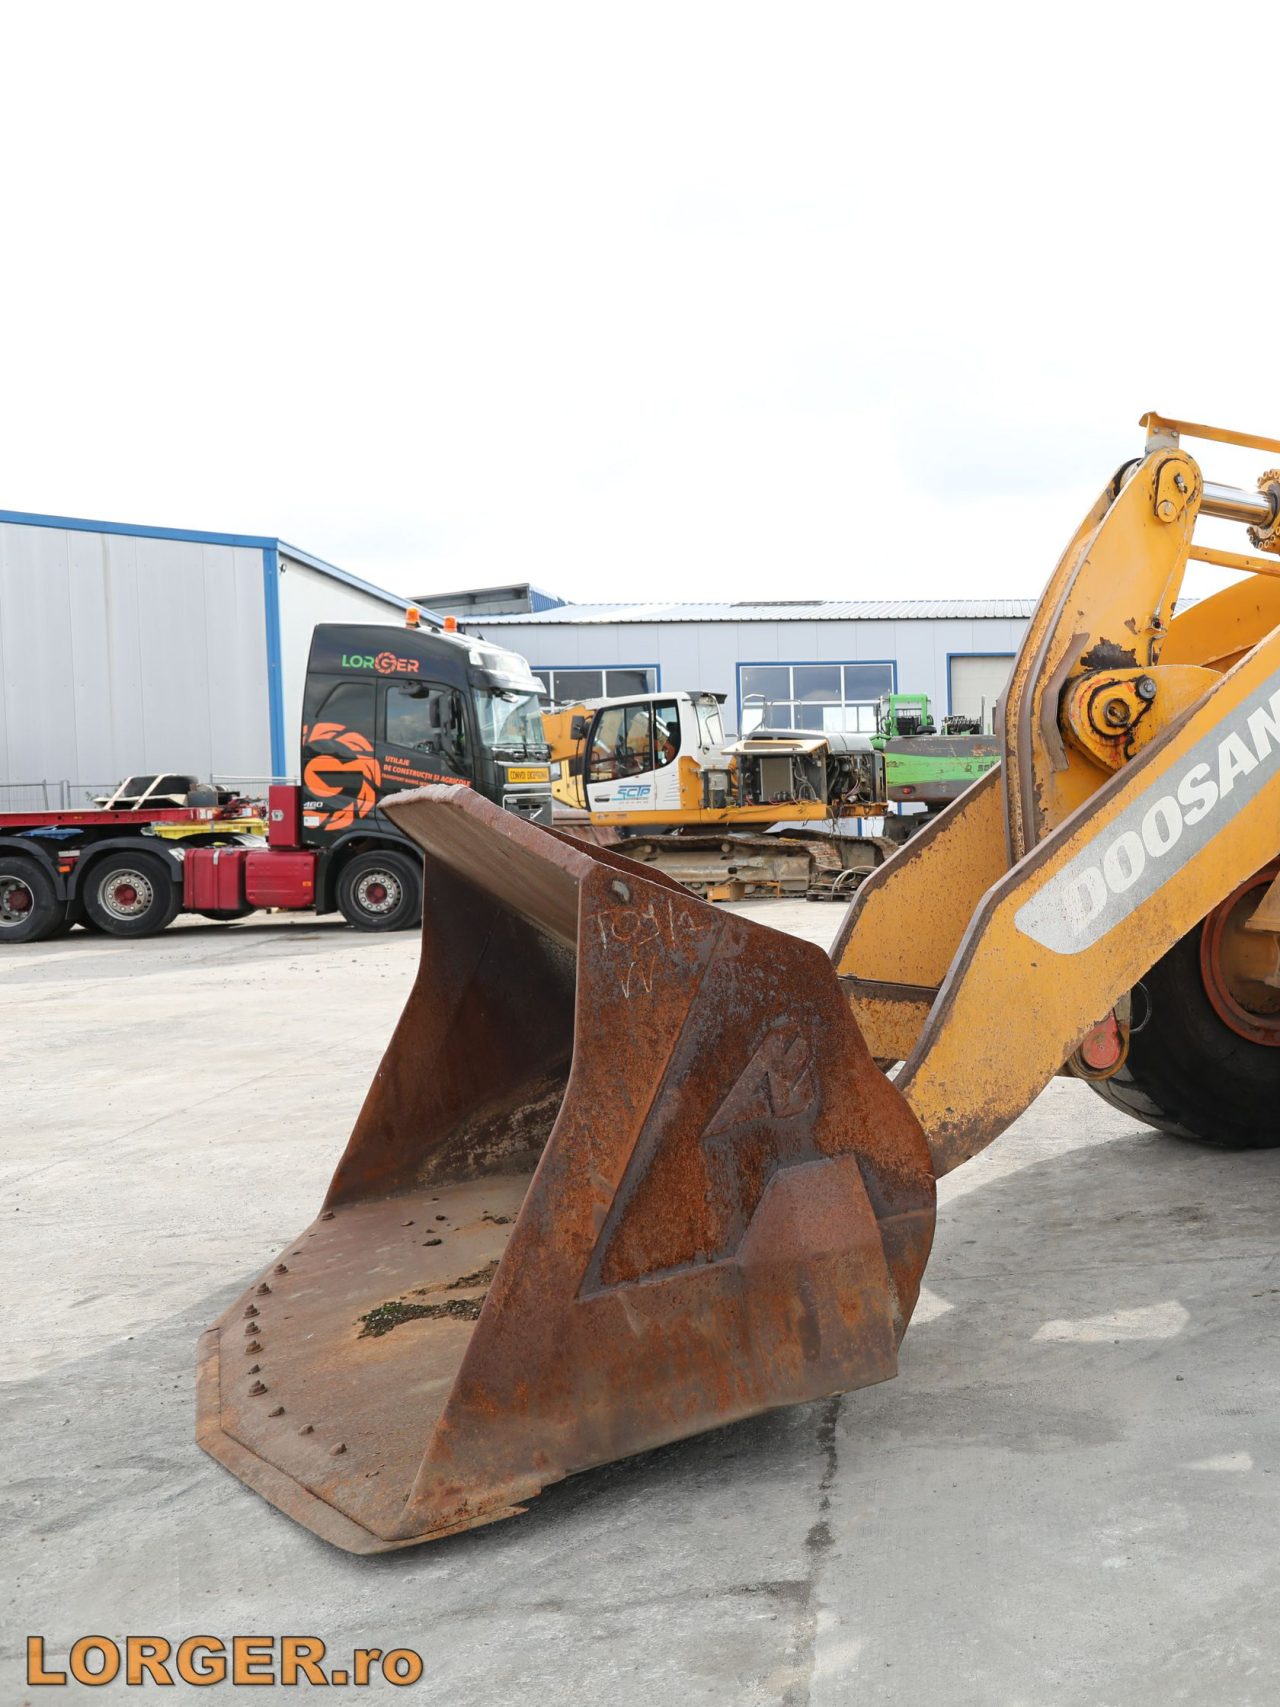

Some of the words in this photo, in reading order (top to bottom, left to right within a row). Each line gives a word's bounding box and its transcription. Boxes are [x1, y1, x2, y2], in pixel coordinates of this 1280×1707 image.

[341, 652, 420, 674] LORGER
[385, 755, 410, 766] UTILAJE
[383, 764, 392, 772] DE
